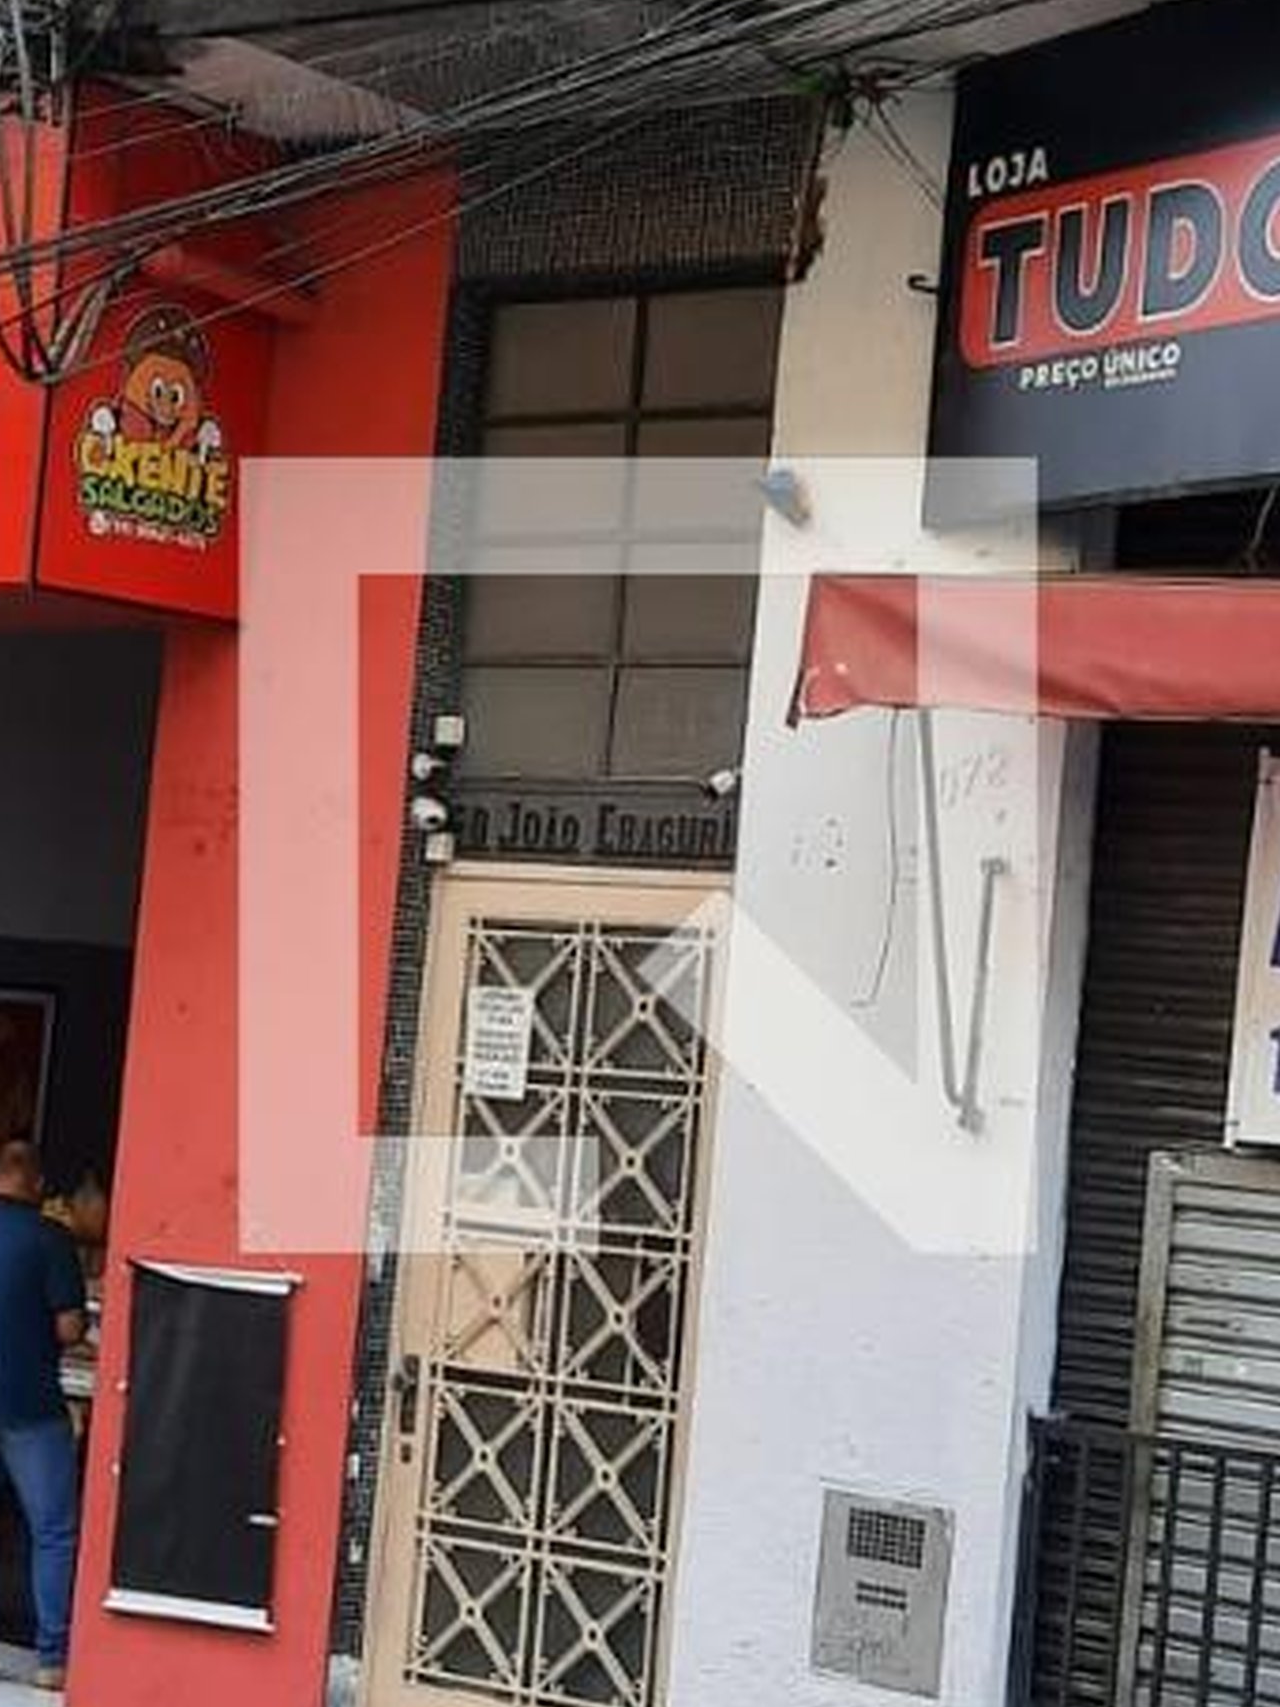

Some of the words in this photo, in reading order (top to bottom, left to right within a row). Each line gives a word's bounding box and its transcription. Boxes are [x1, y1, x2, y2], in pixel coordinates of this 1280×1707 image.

[968, 147, 1049, 197] LOJA
[1020, 355, 1099, 390] PREÇO
[1103, 342, 1181, 375] ÚNICO
[78, 432, 229, 510] OXENTE
[79, 474, 220, 535] SALGADOS
